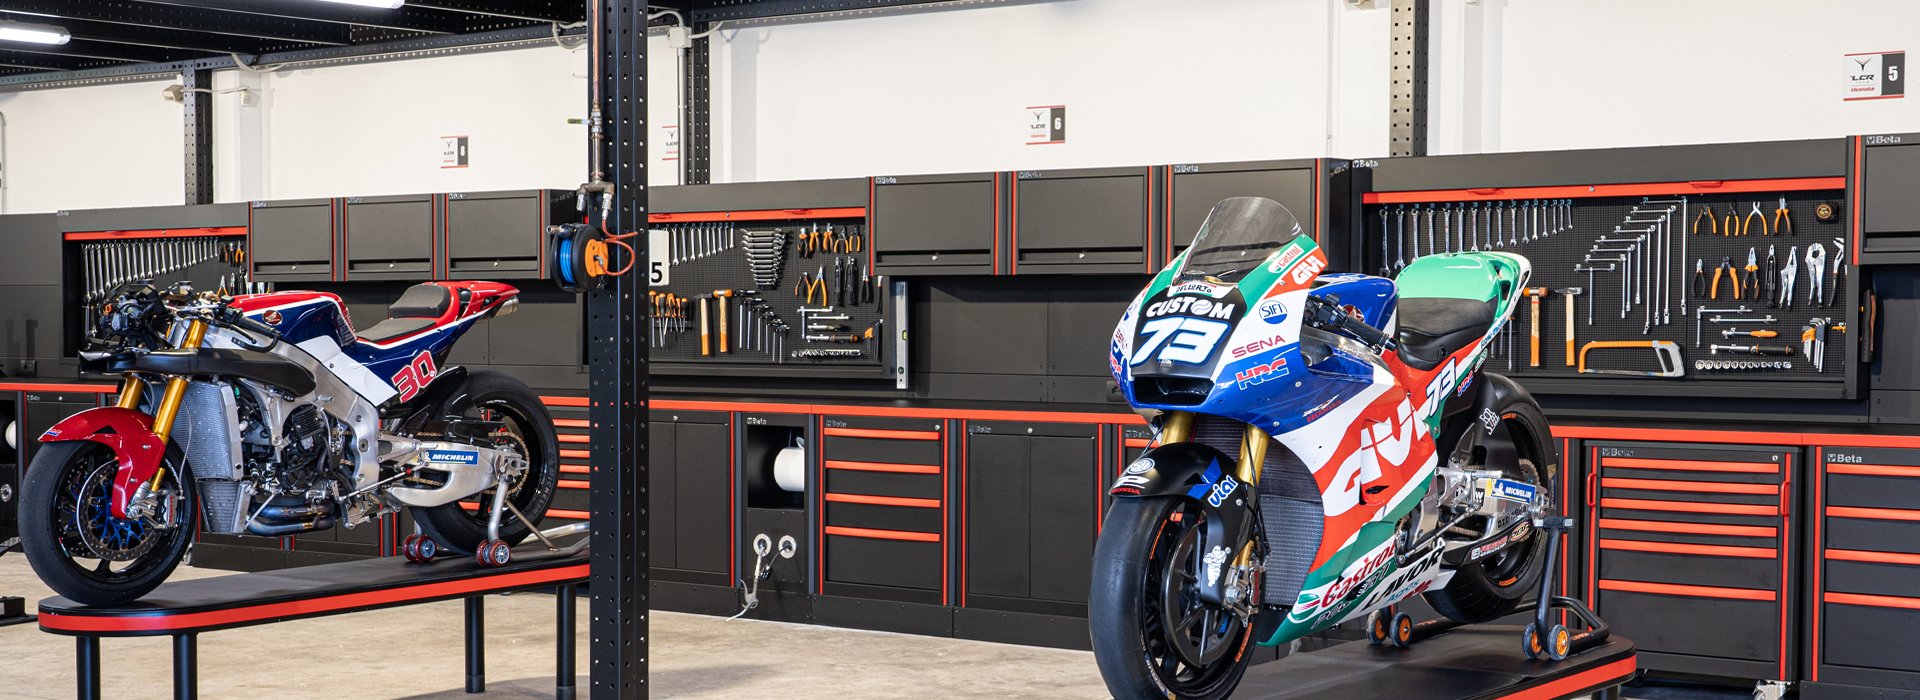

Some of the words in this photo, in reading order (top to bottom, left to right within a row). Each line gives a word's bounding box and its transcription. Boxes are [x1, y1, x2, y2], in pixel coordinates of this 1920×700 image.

[1888, 66, 1898, 81] 5
[1054, 117, 1062, 130] 6
[1875, 135, 1901, 144] Beta
[1278, 245, 1303, 269] Castrol
[1291, 254, 1326, 285] GIVI
[1261, 304, 1284, 318] SIFI
[1130, 315, 1232, 367] 73
[1232, 335, 1286, 358] SENA
[392, 350, 437, 403] 30
[1426, 357, 1456, 417] 73
[432, 453, 475, 461] MICHELIN
[1837, 453, 1863, 463] Beta
[1207, 474, 1239, 508] viar
[1360, 547, 1445, 612] LAVOR
